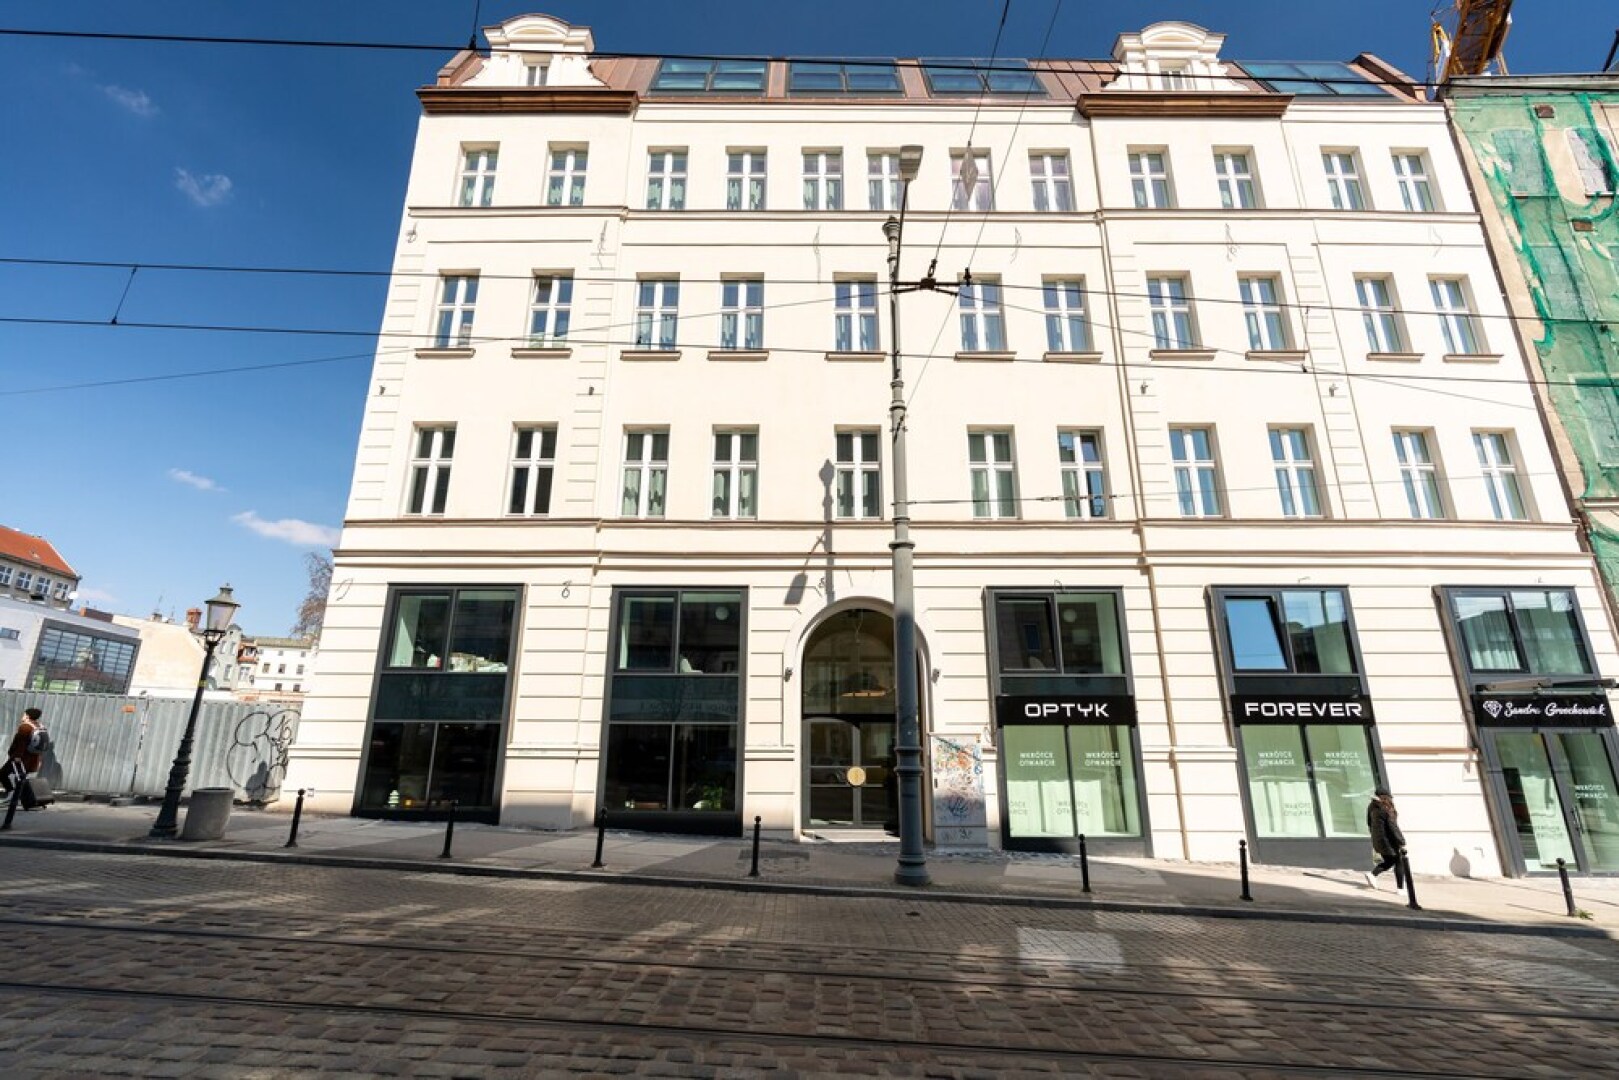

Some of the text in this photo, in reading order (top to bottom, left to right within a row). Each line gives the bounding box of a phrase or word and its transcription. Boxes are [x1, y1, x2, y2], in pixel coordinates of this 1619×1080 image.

[1024, 703, 1110, 717] OPTYK
[1245, 702, 1362, 717] FOREVER
[1504, 701, 1541, 717] Sandra
